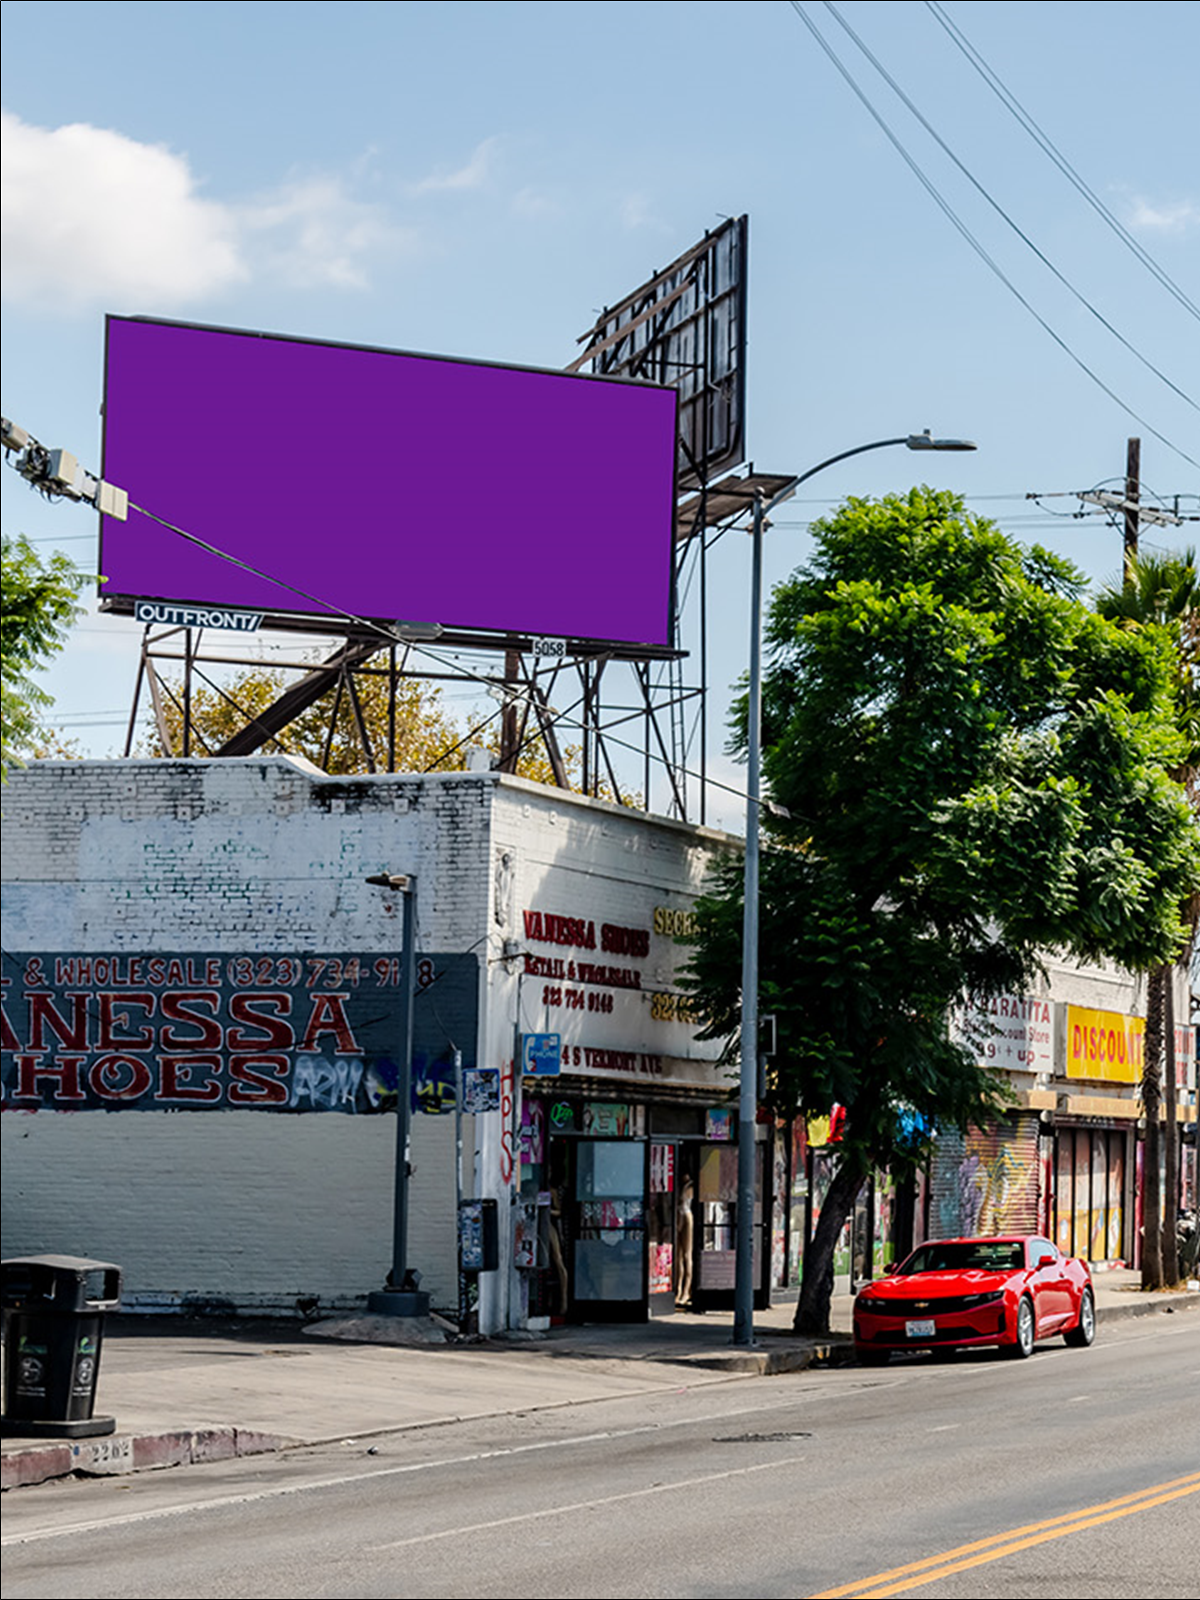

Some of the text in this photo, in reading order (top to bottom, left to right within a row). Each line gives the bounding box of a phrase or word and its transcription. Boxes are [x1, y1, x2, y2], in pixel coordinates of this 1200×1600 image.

[534, 640, 565, 657] 5058
[523, 909, 650, 958] VANESSA SHOES
[24, 957, 49, 987] &
[55, 957, 223, 988] WHOLESALE
[304, 957, 435, 990] 734-918
[529, 1049, 558, 1060] PHONE
[1017, 1050, 1036, 1067] up
[1073, 1024, 1142, 1065] DISCOUNT
[582, 1047, 637, 1073] VERMONT
[639, 1053, 664, 1076] AVE
[0, 1053, 290, 1105] HOES
